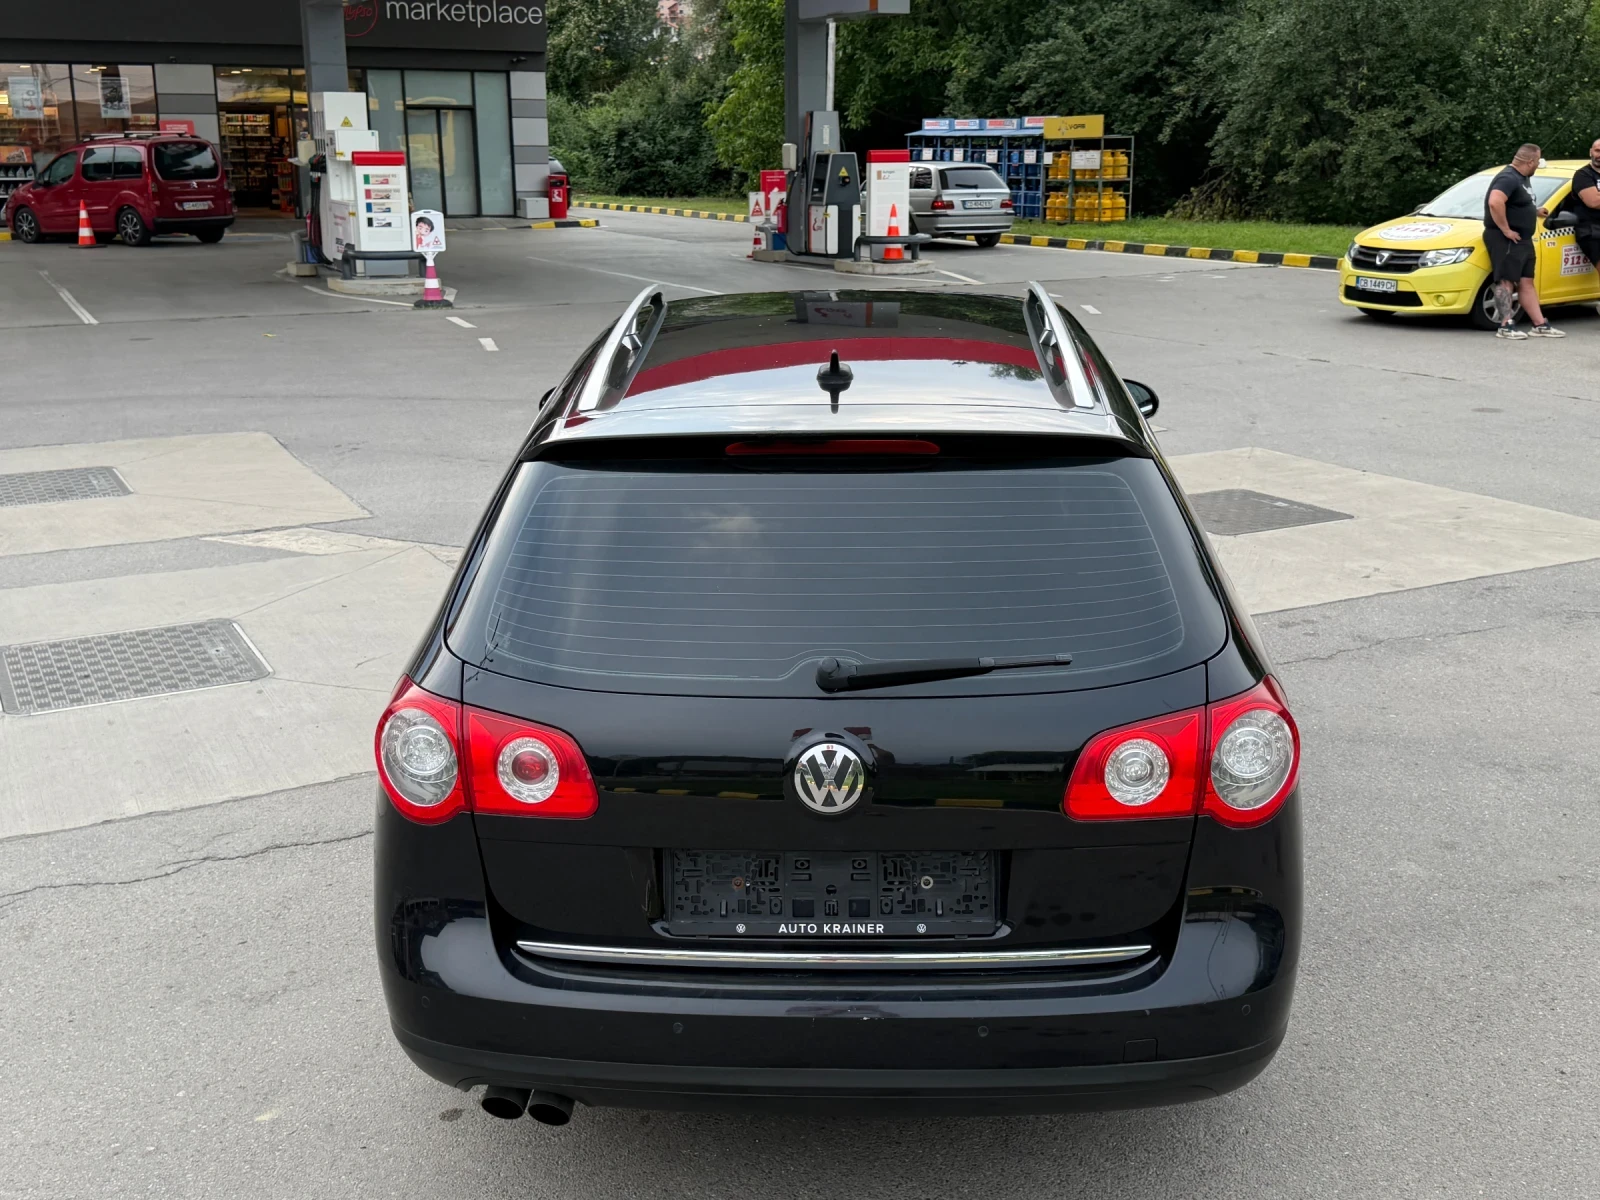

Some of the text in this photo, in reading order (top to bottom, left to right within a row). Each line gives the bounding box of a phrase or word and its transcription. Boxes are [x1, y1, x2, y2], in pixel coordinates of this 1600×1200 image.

[386, 0, 543, 28] marketplace
[778, 923, 817, 934] AUTO
[824, 923, 884, 934] KRAINER
